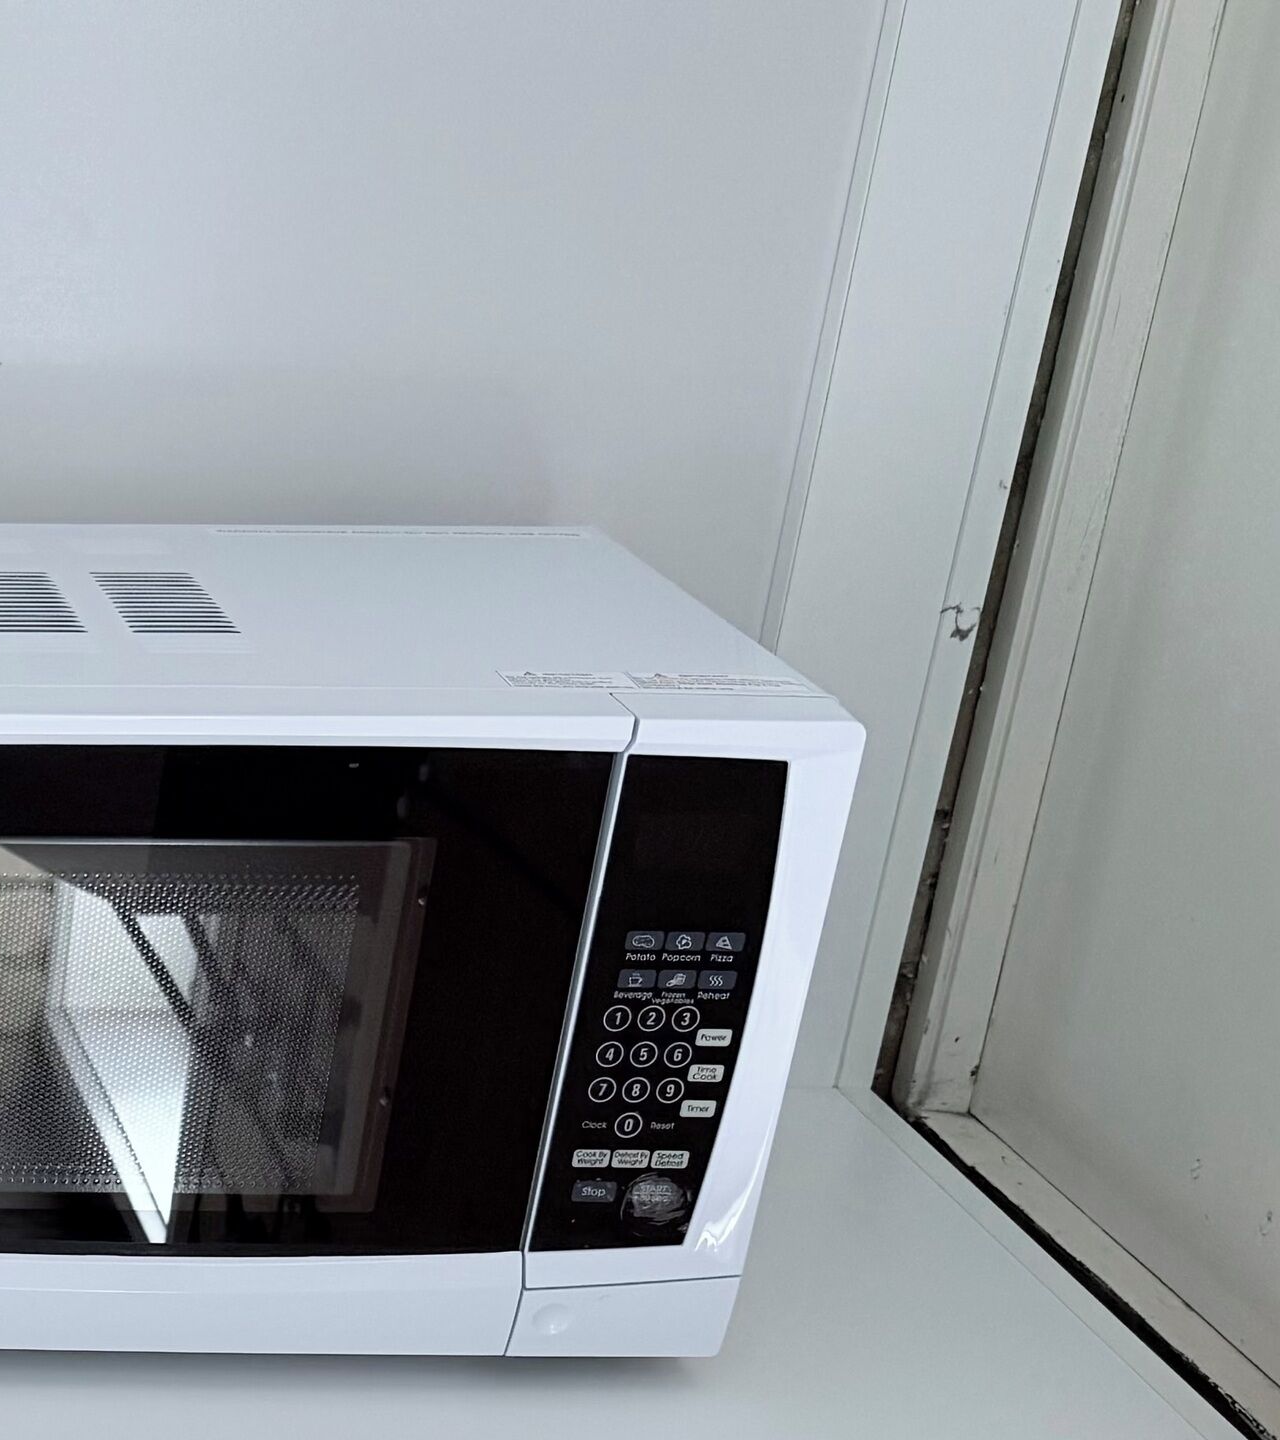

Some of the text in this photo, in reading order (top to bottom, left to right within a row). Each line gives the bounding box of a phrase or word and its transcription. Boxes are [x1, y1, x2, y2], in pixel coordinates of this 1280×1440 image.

[625, 952, 657, 962] Potato
[661, 953, 702, 963] Popcorn
[710, 953, 734, 963] Pizza
[697, 991, 731, 1001] Reheat
[615, 1011, 622, 1026] 1
[646, 1011, 657, 1026] 2
[680, 1012, 691, 1026] 3
[604, 1047, 615, 1061] 4
[638, 1047, 650, 1061] 5
[673, 1048, 683, 1062] 6
[598, 1083, 608, 1097] 7
[631, 1083, 641, 1097] 8
[665, 1084, 675, 1098] 9
[581, 1120, 608, 1130] Clock
[624, 1118, 634, 1133] 0
[581, 1186, 607, 1198] Stop
